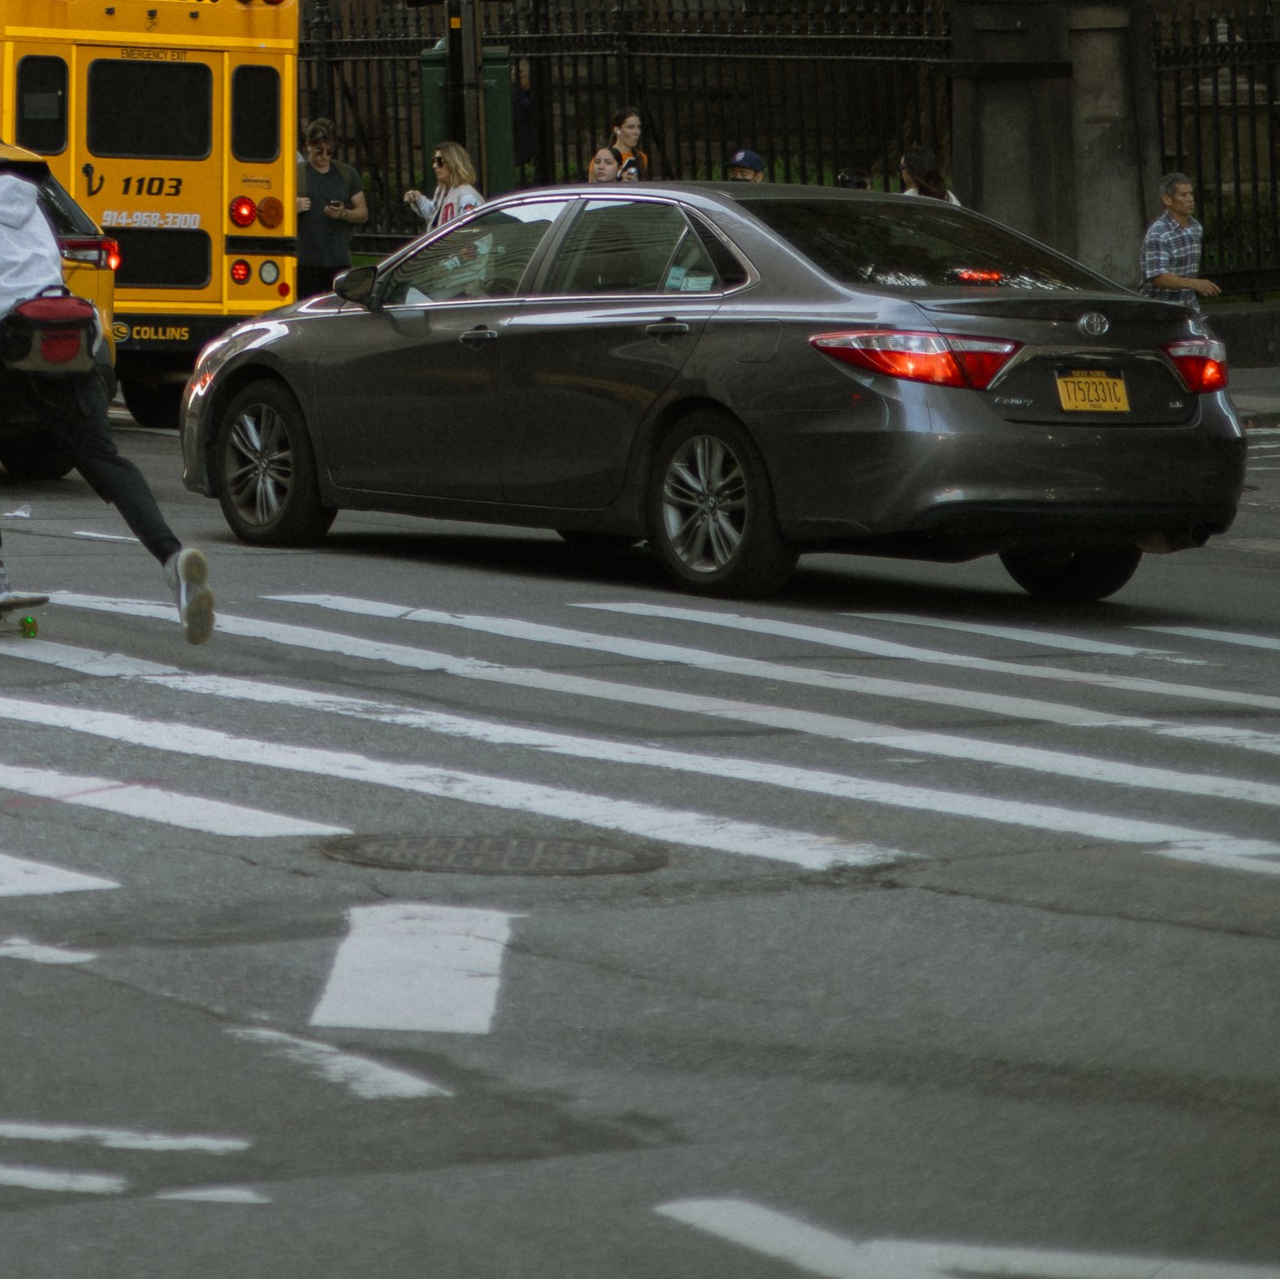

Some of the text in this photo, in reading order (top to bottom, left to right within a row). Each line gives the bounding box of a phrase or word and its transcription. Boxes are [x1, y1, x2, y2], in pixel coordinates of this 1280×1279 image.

[121, 49, 188, 61] EMERGENCY EXIT
[122, 177, 183, 196] 1103
[101, 210, 201, 228] 914-968-3300
[132, 326, 190, 340] COLLINS
[1063, 381, 1121, 403] T752331C
